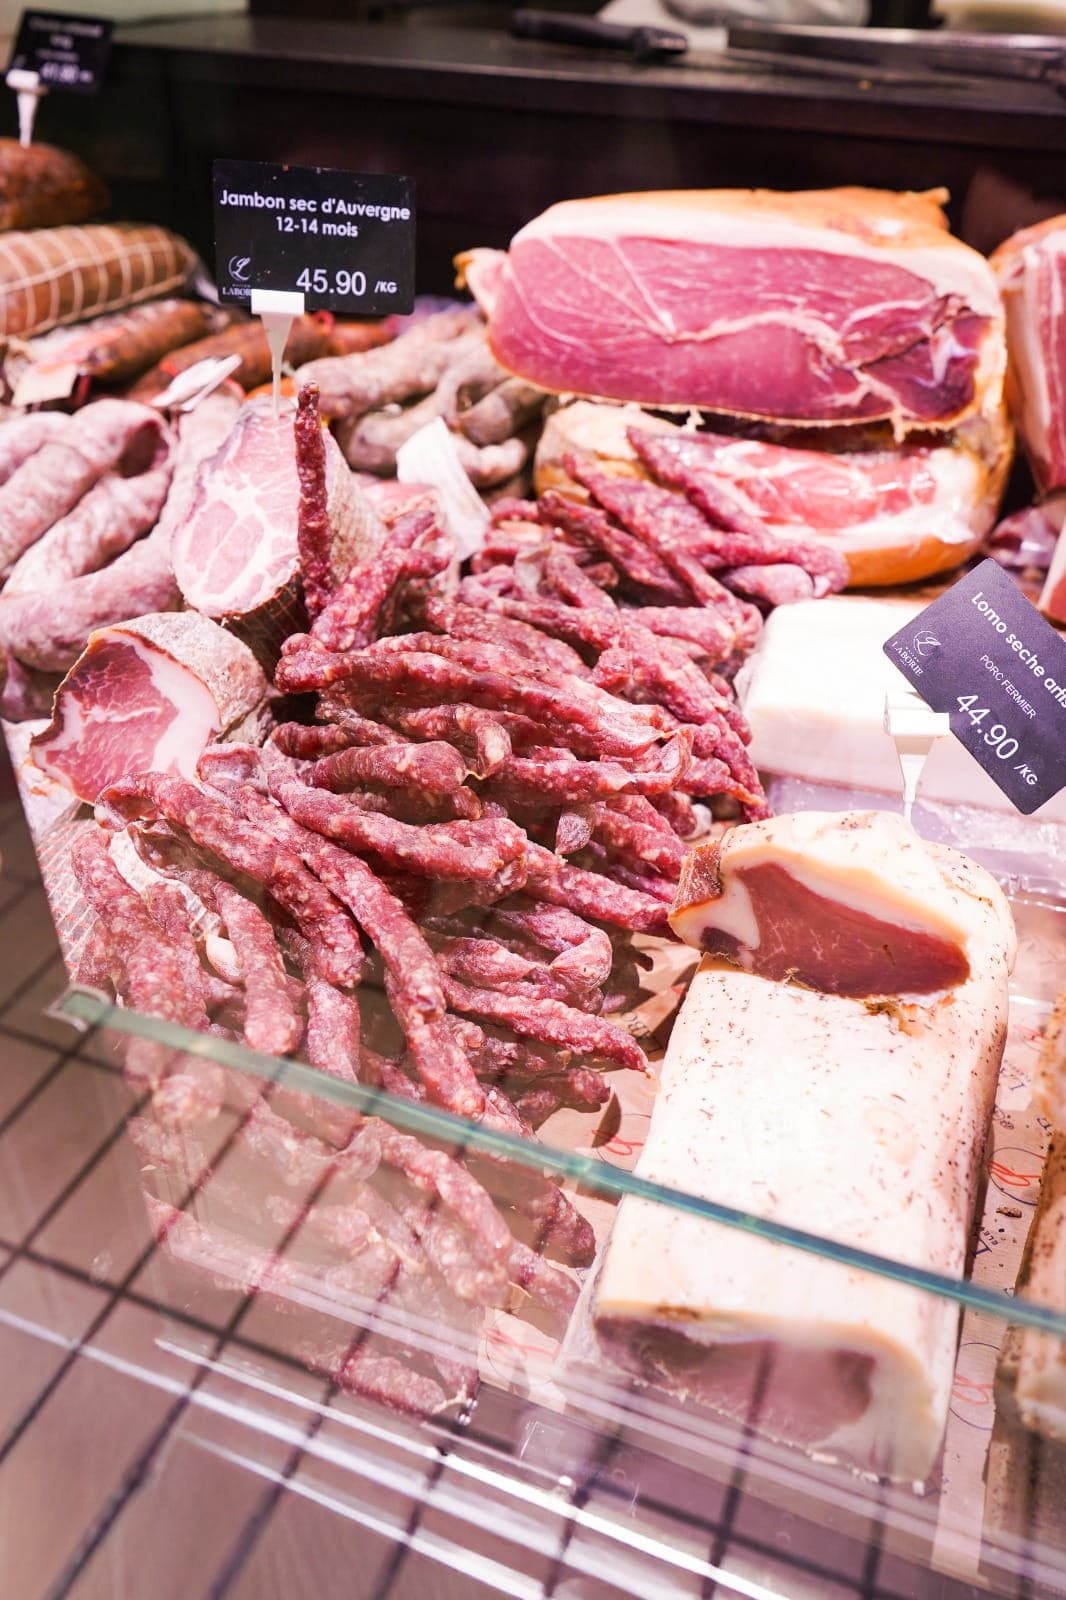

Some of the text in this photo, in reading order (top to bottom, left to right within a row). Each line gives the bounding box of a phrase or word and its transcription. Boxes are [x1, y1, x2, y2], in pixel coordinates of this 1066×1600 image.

[220, 190, 411, 222] Jambon sec d'Auvergne
[276, 216, 358, 237] 12-14 mois
[296, 267, 398, 296] 45.90 /KG
[971, 592, 1008, 633] Lomo
[1005, 632, 1046, 677] seche
[891, 641, 924, 677] LABORIE
[979, 654, 1037, 720] PORC FERMIER
[956, 693, 1039, 786] 44.90 /KG
